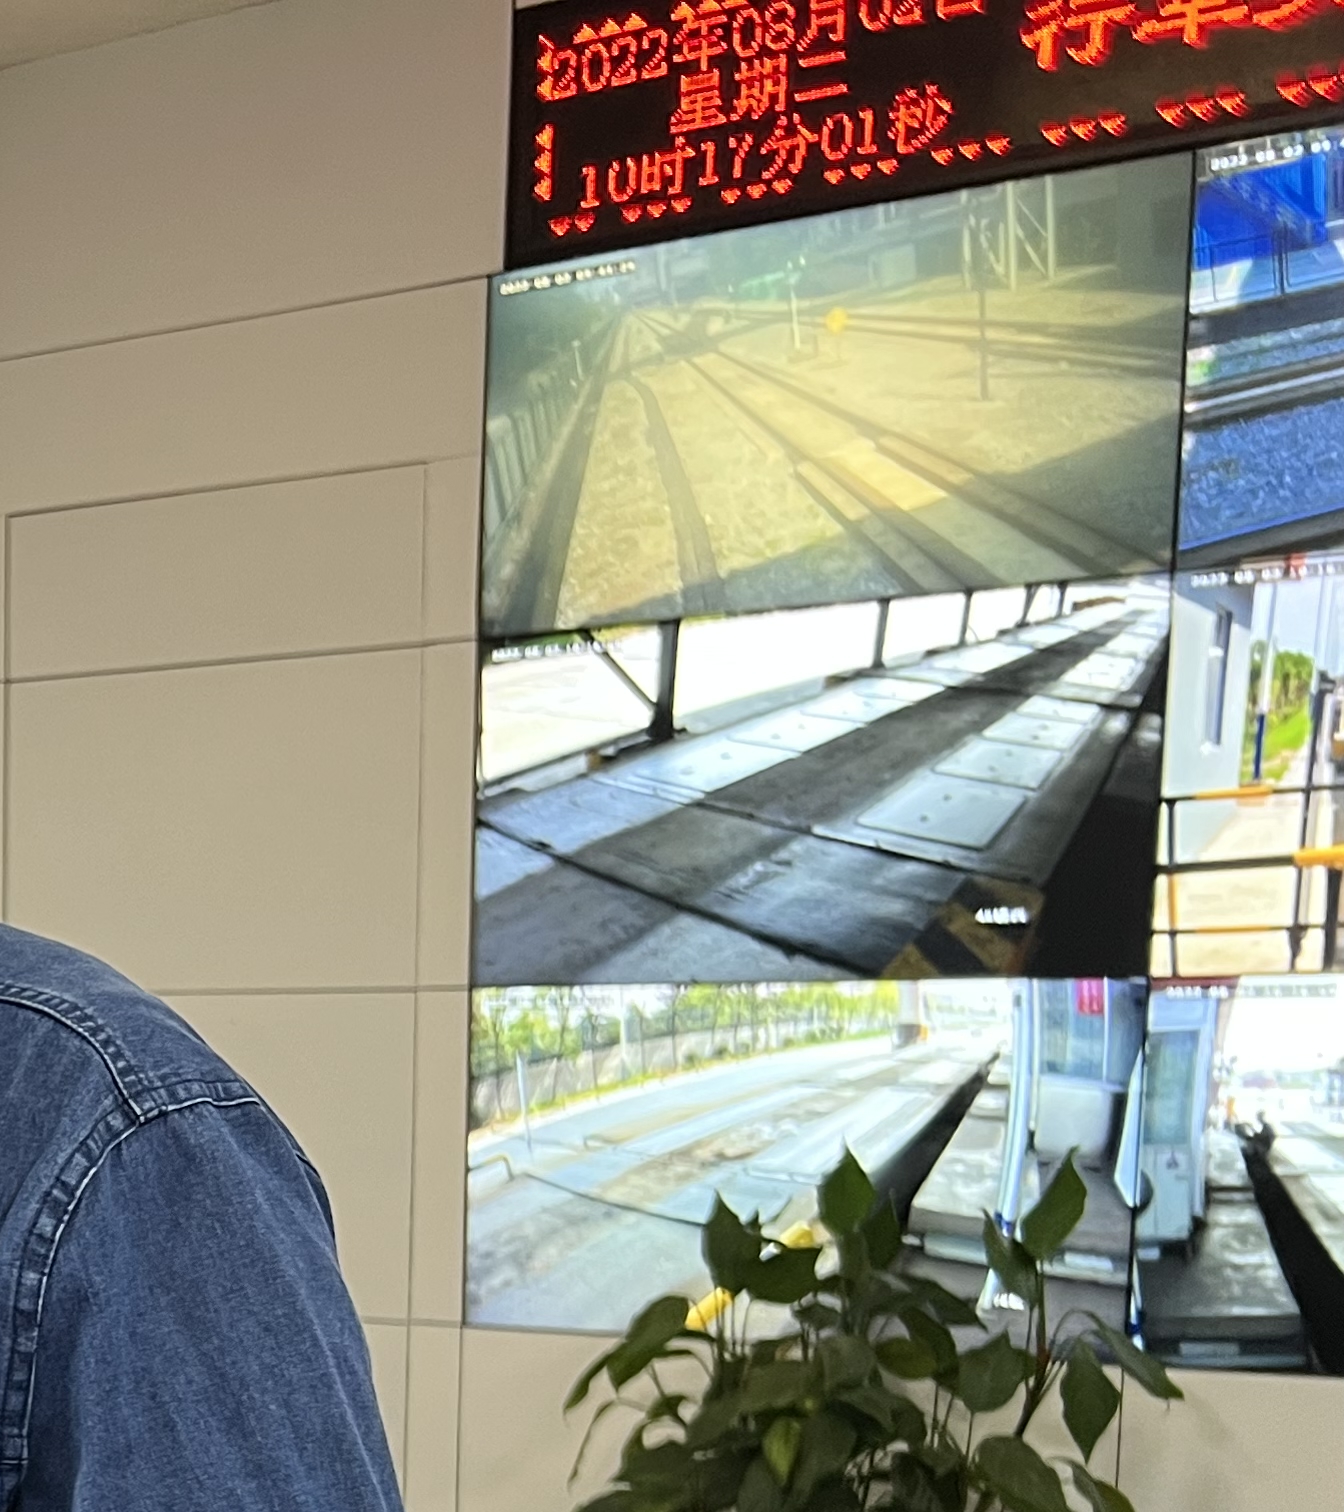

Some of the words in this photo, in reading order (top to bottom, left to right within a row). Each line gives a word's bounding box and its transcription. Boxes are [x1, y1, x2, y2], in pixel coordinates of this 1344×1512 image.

[670, 52, 849, 134] 星期二
[580, 83, 953, 209] 10时17分01秒
